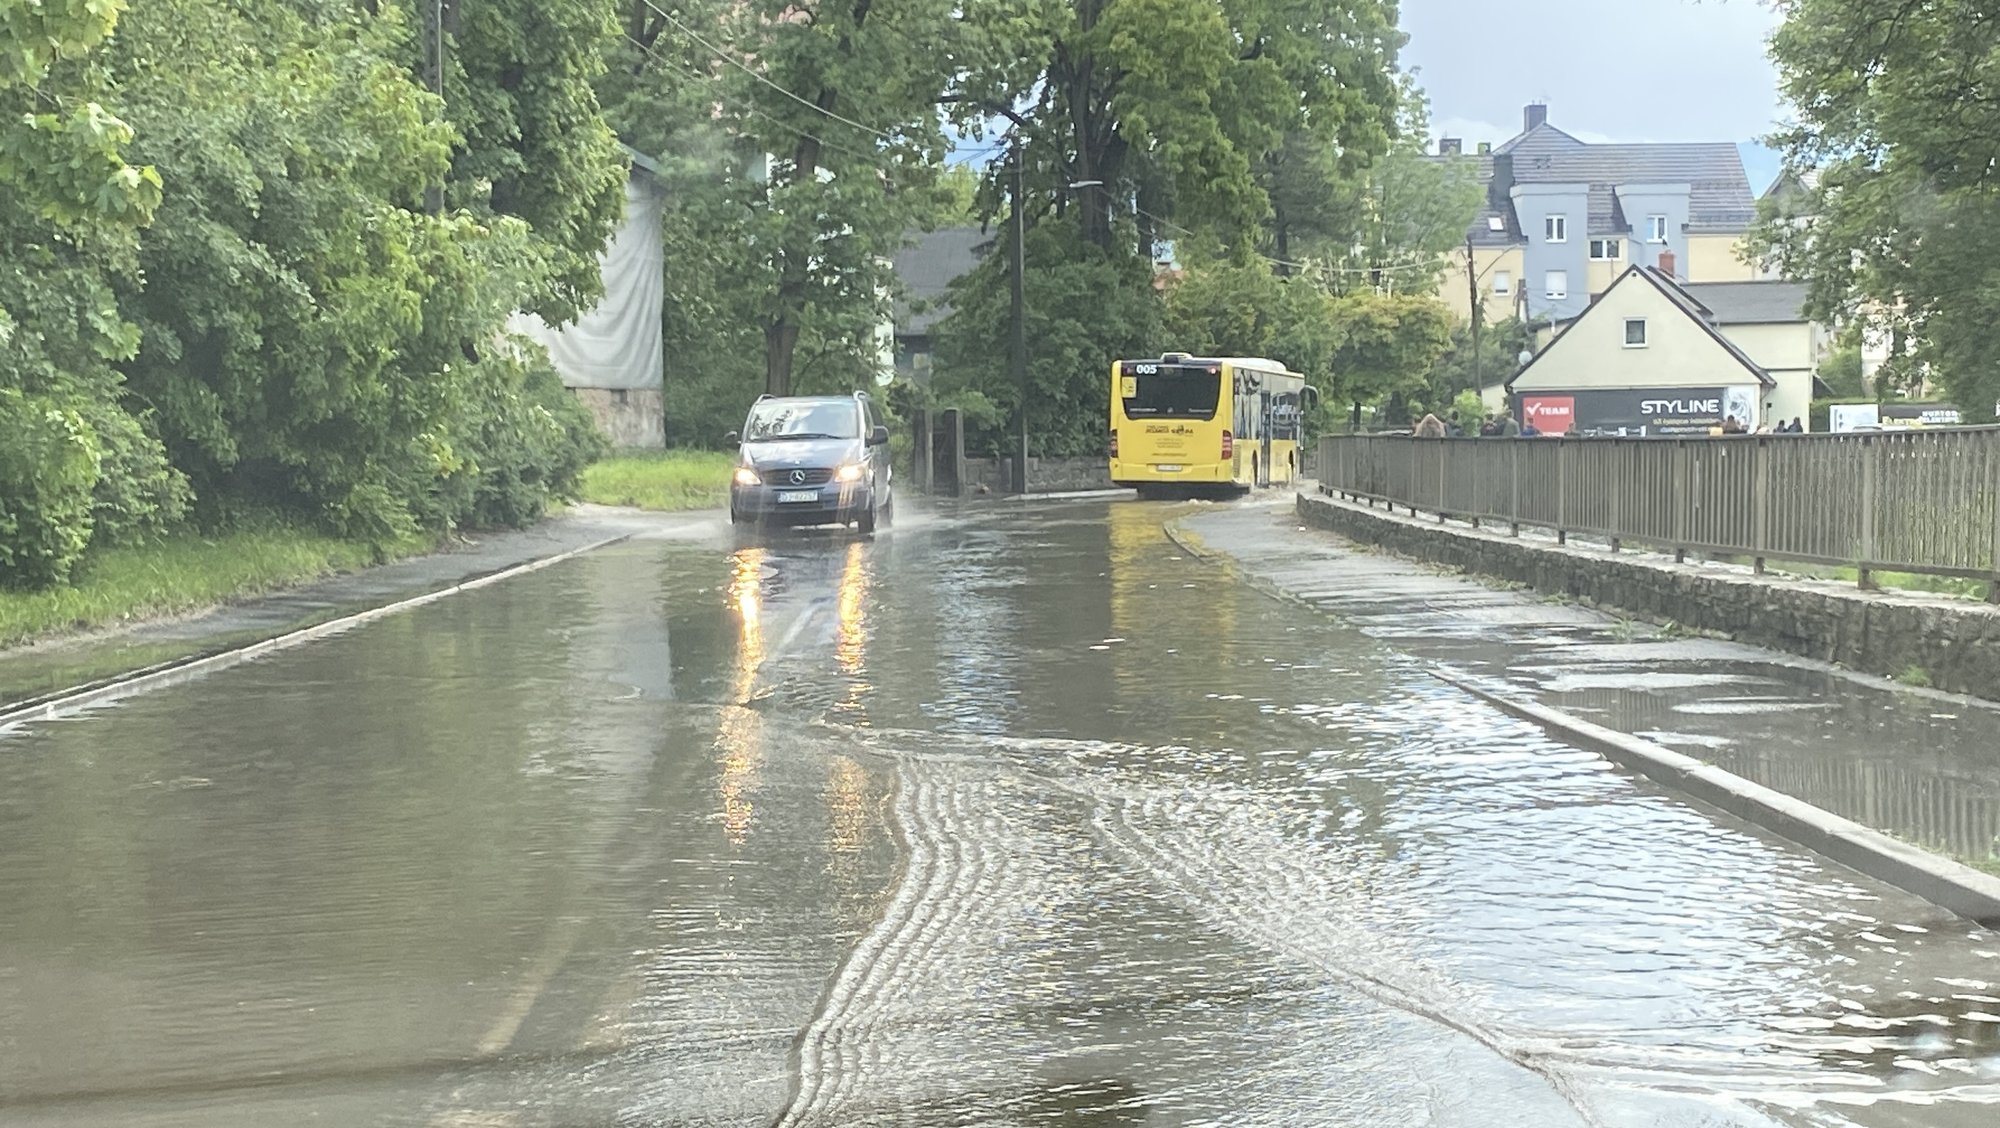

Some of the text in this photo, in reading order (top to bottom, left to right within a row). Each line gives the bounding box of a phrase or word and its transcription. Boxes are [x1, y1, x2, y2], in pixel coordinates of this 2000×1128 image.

[1136, 364, 1158, 375] 005
[1539, 407, 1569, 415] TEAM
[1641, 399, 1720, 414] STYLINE
